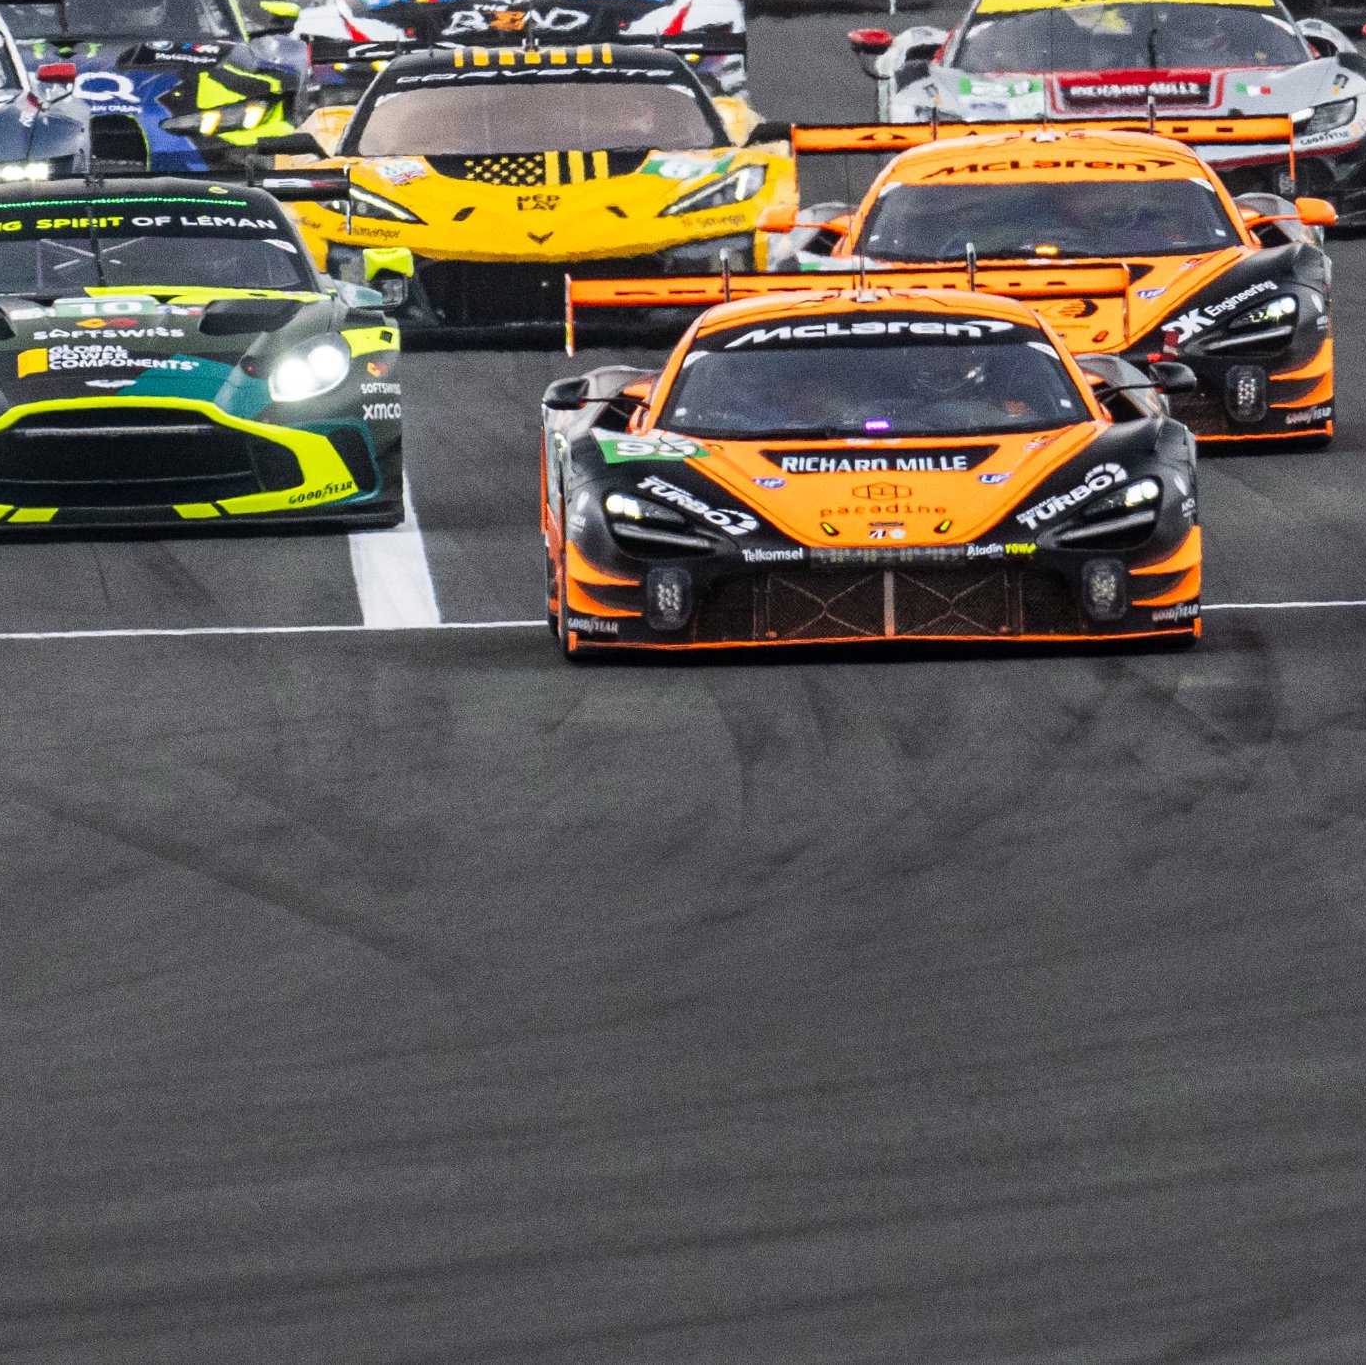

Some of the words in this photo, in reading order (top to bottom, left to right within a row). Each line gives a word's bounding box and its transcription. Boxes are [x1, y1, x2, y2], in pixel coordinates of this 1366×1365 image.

[396, 68, 676, 85] CORVETTE
[921, 159, 1149, 179] McLaren
[35, 215, 124, 230] SPIRIT
[132, 215, 175, 228] OF
[1204, 279, 1278, 318] Engineering
[69, 301, 144, 316] 10
[33, 326, 186, 341] SOFTSWISS
[723, 320, 983, 349] McLaren
[48, 343, 124, 354] GLOBAL
[48, 350, 129, 362] POWER
[781, 456, 888, 473] RICHARD
[896, 455, 969, 472] MILLE
[820, 502, 947, 519] paradine
[742, 547, 804, 563] Telkomsel
[967, 542, 1004, 557] Aladin
